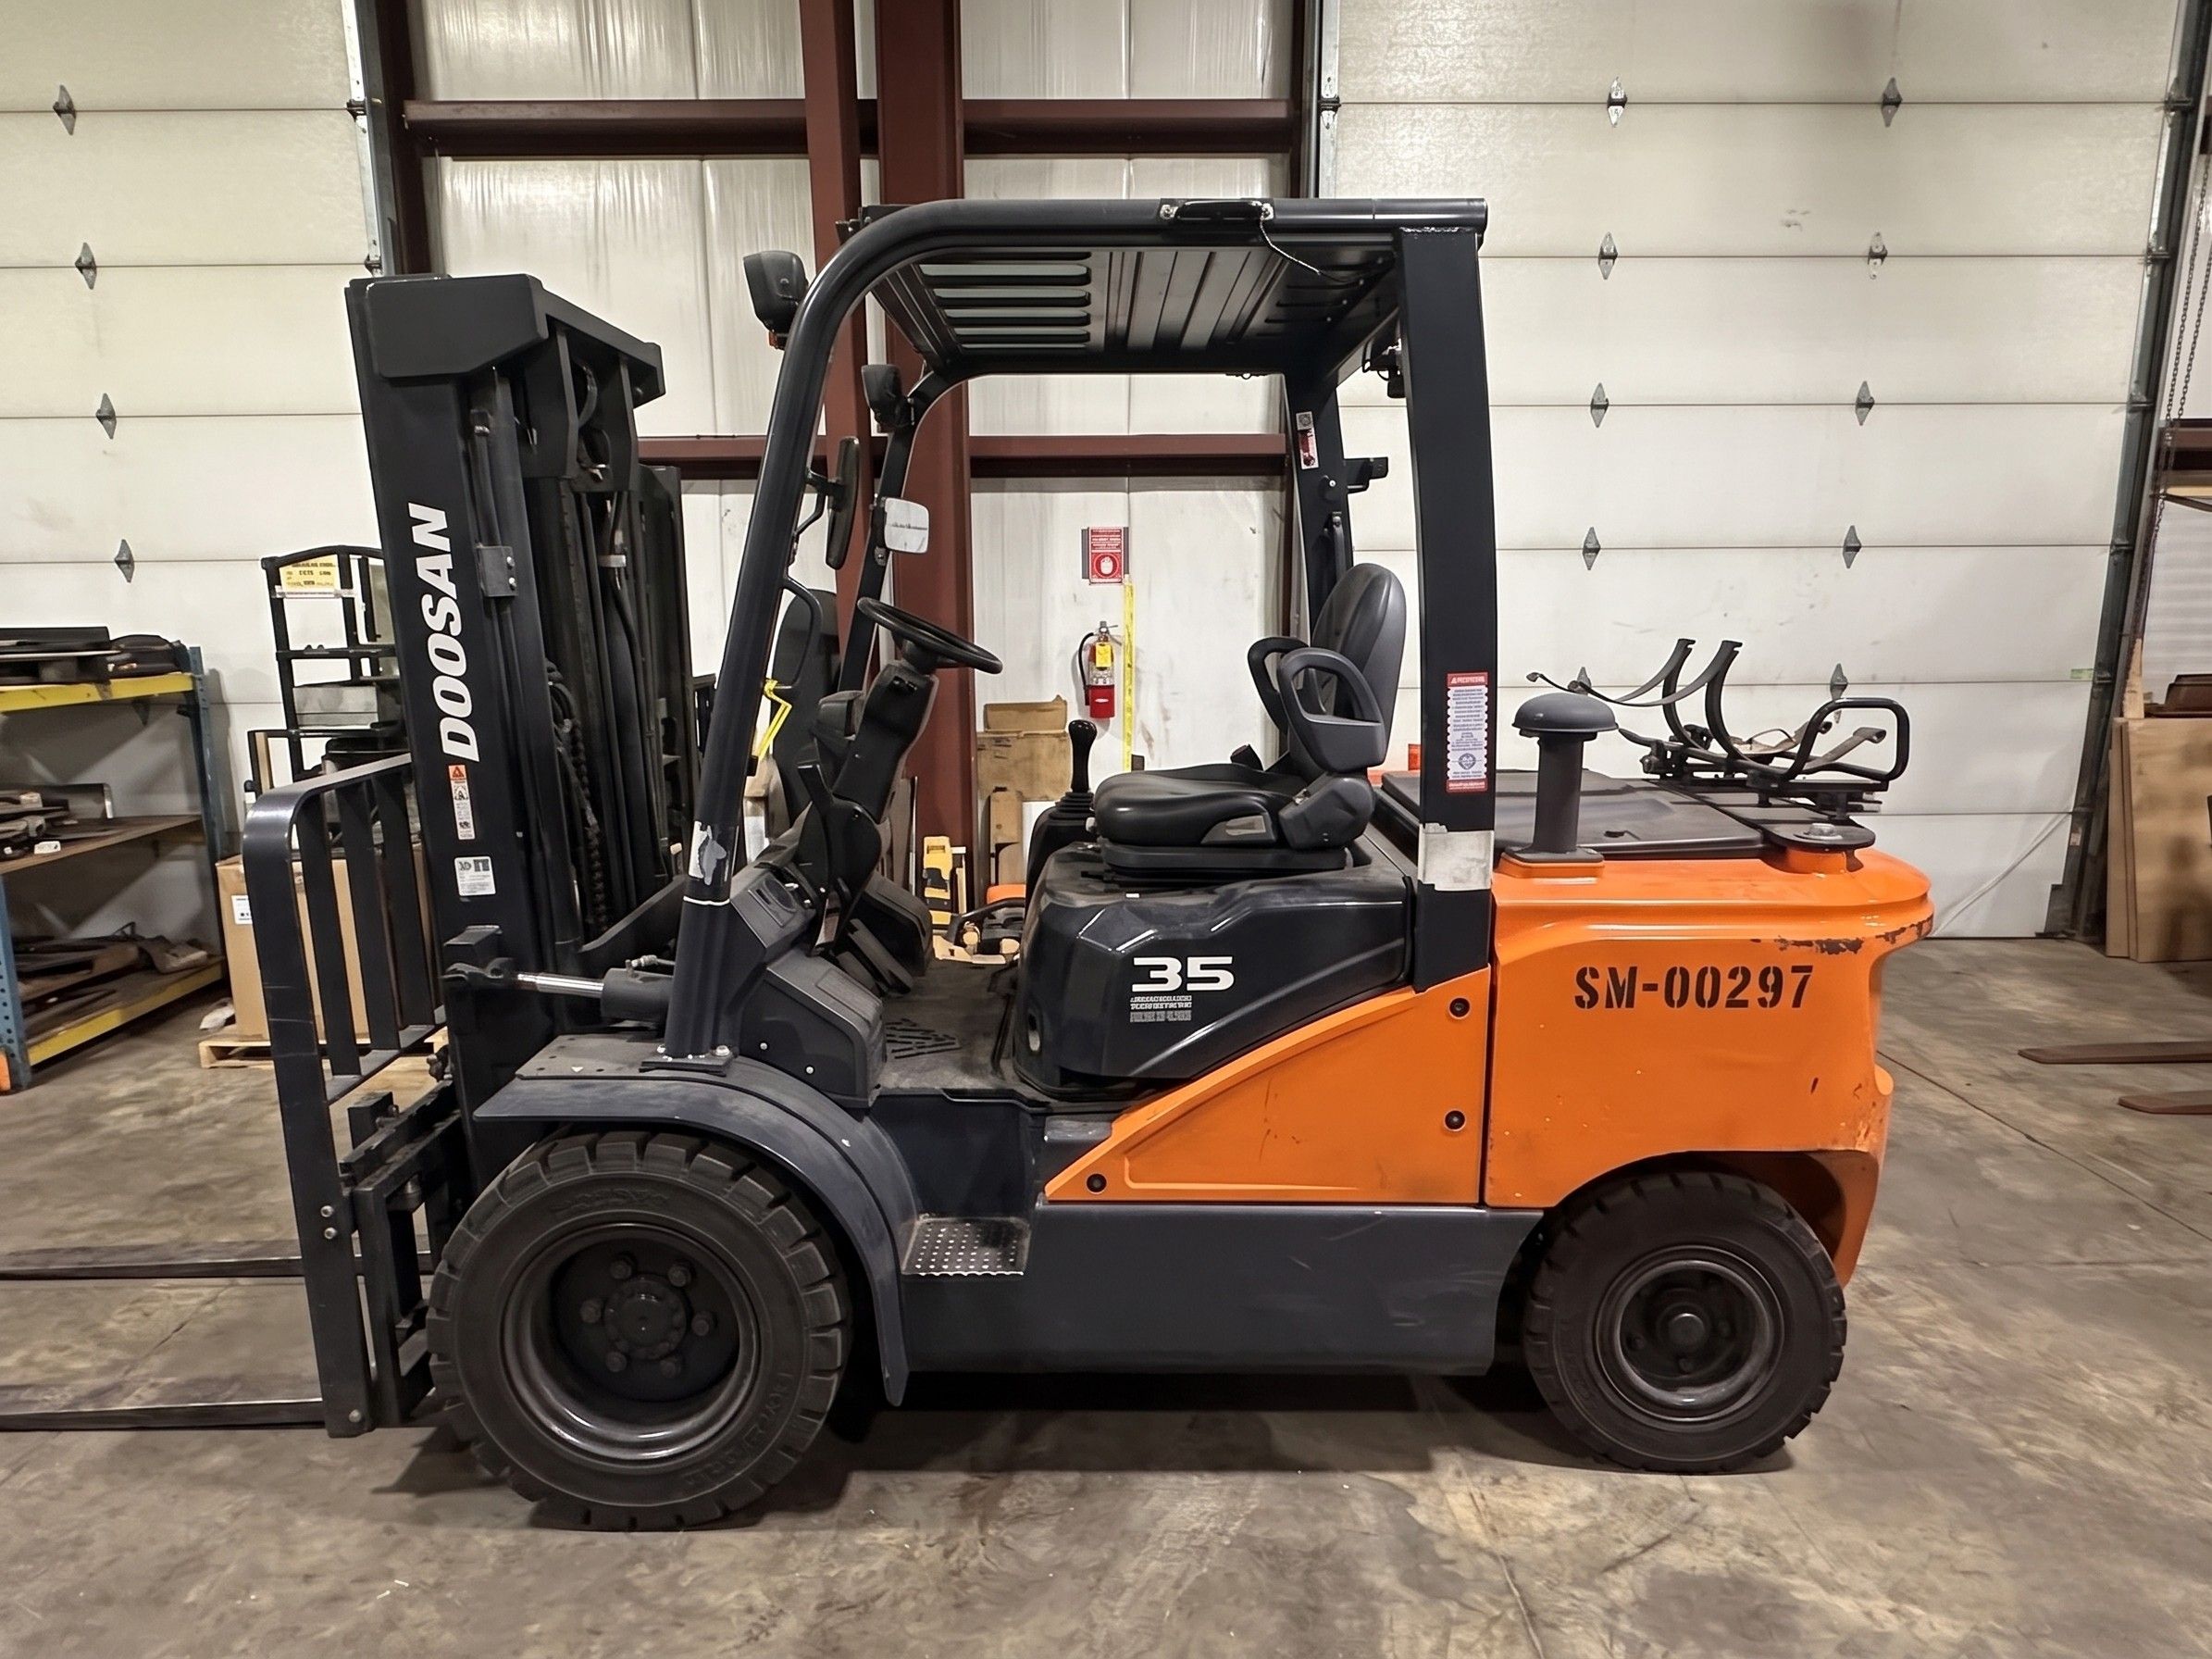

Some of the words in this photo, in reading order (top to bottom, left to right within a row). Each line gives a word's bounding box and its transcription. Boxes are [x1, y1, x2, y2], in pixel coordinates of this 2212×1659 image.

[408, 503, 480, 762] DOOSAN
[1132, 956, 1235, 992] 35
[1574, 966, 1813, 1009] SM-00297
